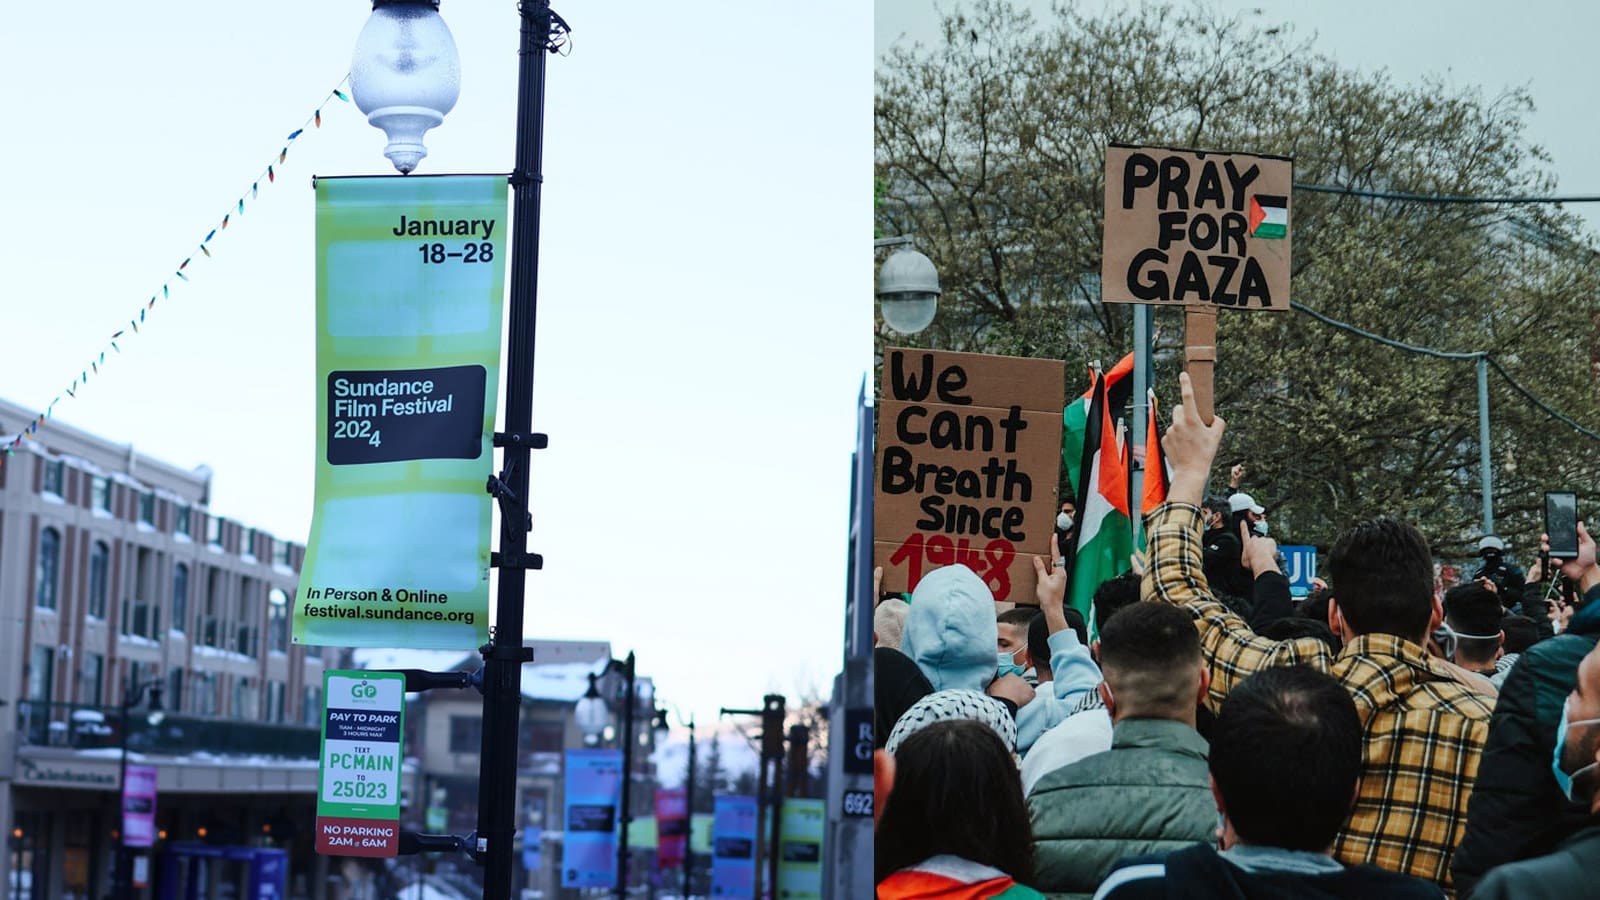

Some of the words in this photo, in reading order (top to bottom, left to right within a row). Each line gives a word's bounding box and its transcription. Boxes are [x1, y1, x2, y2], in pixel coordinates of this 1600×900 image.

[1122, 152, 1260, 211] PRAY
[392, 215, 495, 240] January
[1158, 211, 1247, 257] FOR
[1126, 248, 1272, 307] GAZA
[334, 378, 433, 397] Sundance
[890, 351, 973, 405] We
[335, 399, 376, 417] Film
[381, 394, 453, 416] Festival
[334, 420, 381, 447] 2024
[881, 446, 1032, 502] Breath
[916, 495, 1026, 542] Since
[307, 587, 320, 599] In
[324, 588, 377, 602] Person
[382, 588, 392, 602] &
[395, 589, 448, 603] Online
[304, 604, 474, 624] festival.sundance.org
[329, 713, 351, 722] PAY
[353, 714, 367, 722] TO
[369, 714, 398, 724] PARK
[330, 753, 393, 771] PCMAIN
[333, 781, 387, 799] 25023
[323, 825, 341, 834] NO
[343, 826, 393, 837] PARKING
[328, 836, 353, 846] 2AM
[361, 838, 387, 848] 6AM
